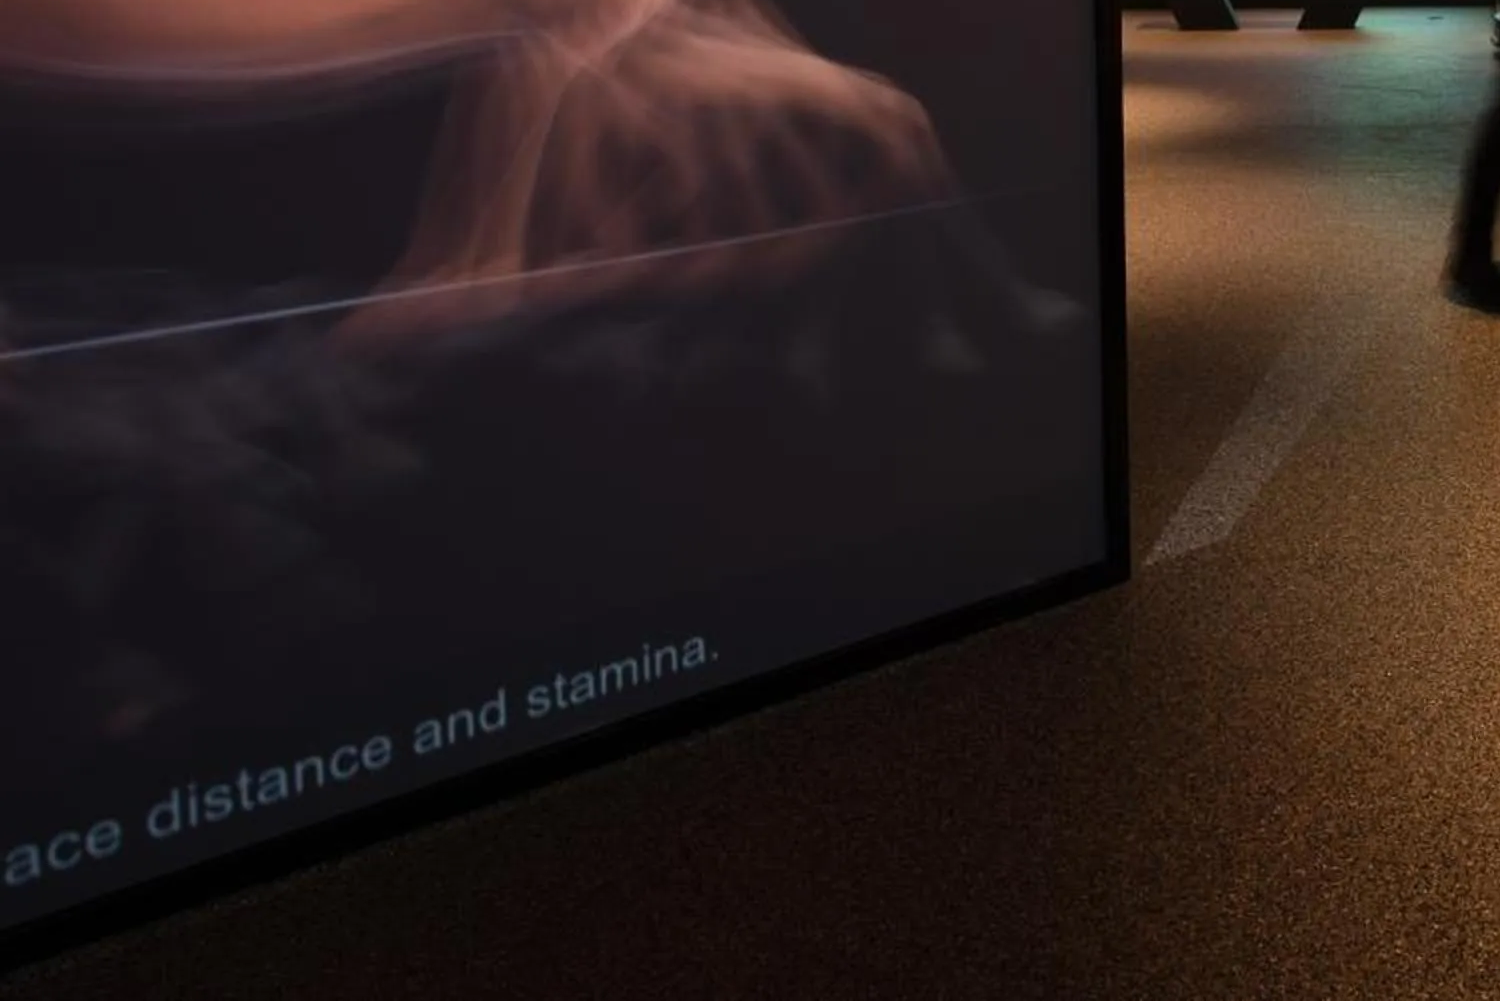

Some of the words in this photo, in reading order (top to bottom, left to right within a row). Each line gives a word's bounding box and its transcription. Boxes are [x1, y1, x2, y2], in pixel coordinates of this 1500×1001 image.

[4, 817, 122, 886] ace
[146, 733, 393, 839] distance
[412, 687, 508, 755] and
[526, 632, 719, 719] stamina.
